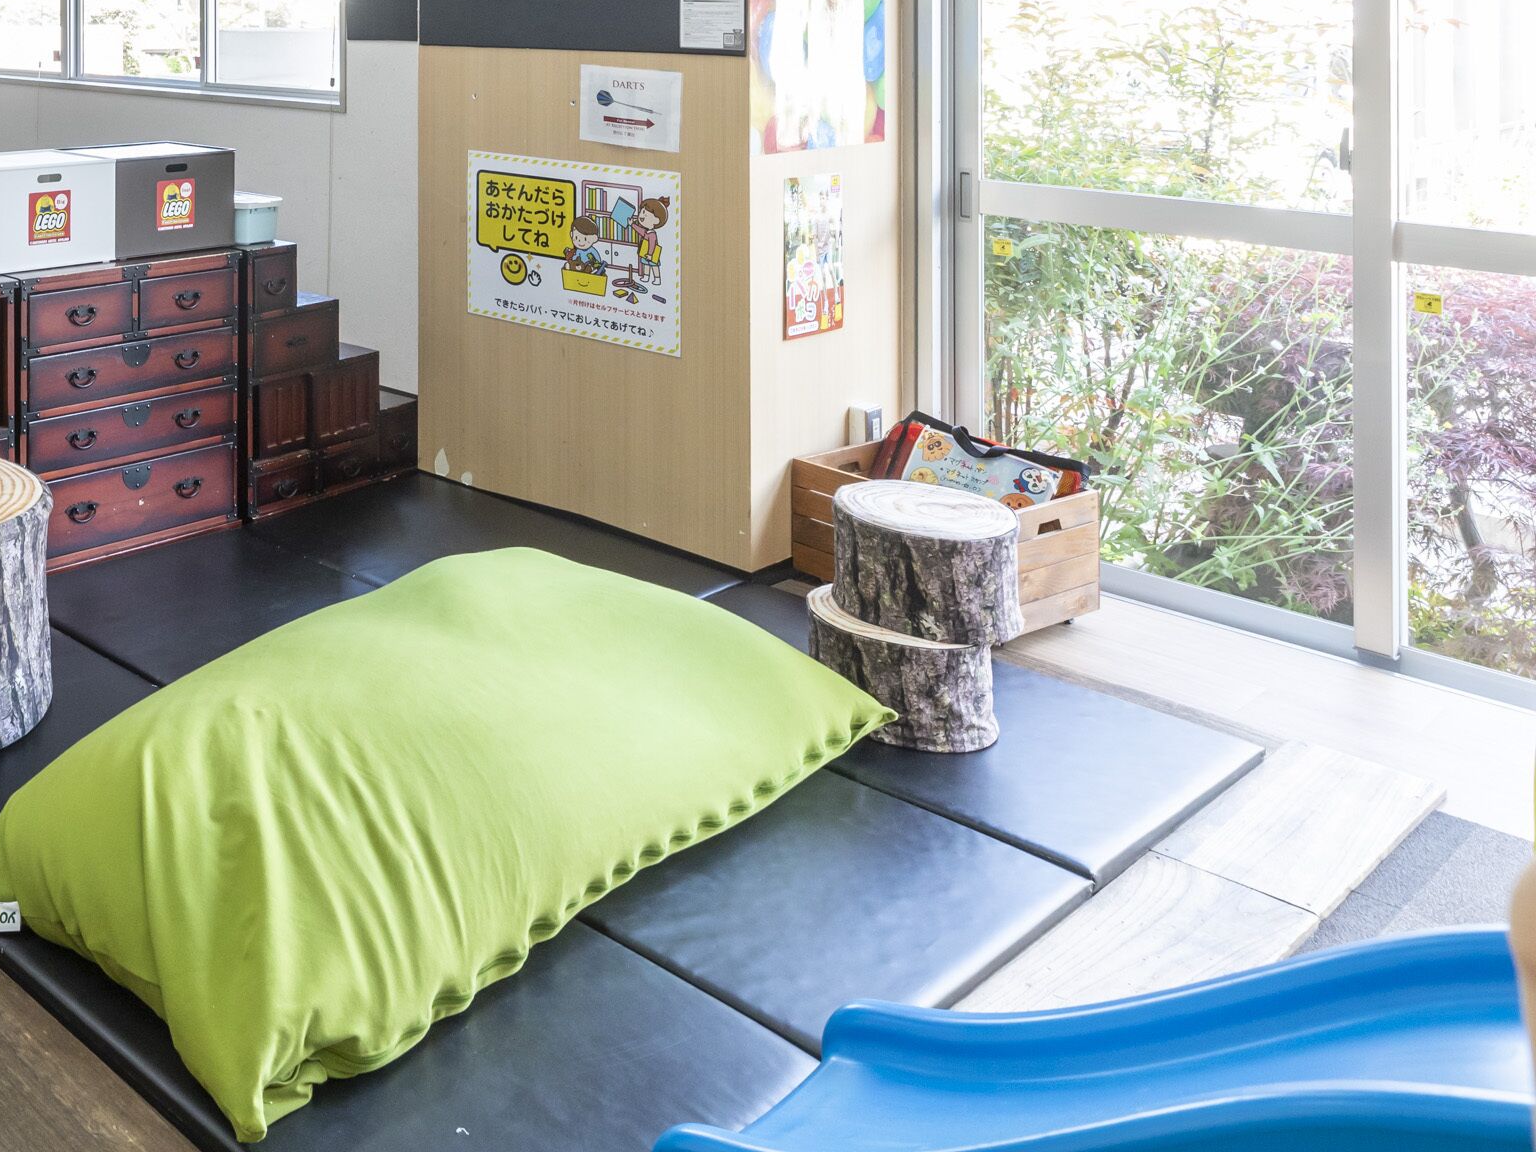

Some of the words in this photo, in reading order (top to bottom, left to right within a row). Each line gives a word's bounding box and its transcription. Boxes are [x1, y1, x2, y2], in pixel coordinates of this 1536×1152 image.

[612, 79, 645, 90] DARTS
[485, 180, 566, 206] あそんだら
[163, 200, 190, 218] LEGO
[485, 201, 566, 228] おかたづけ
[35, 212, 66, 231] LEGO
[502, 225, 550, 248] してね
